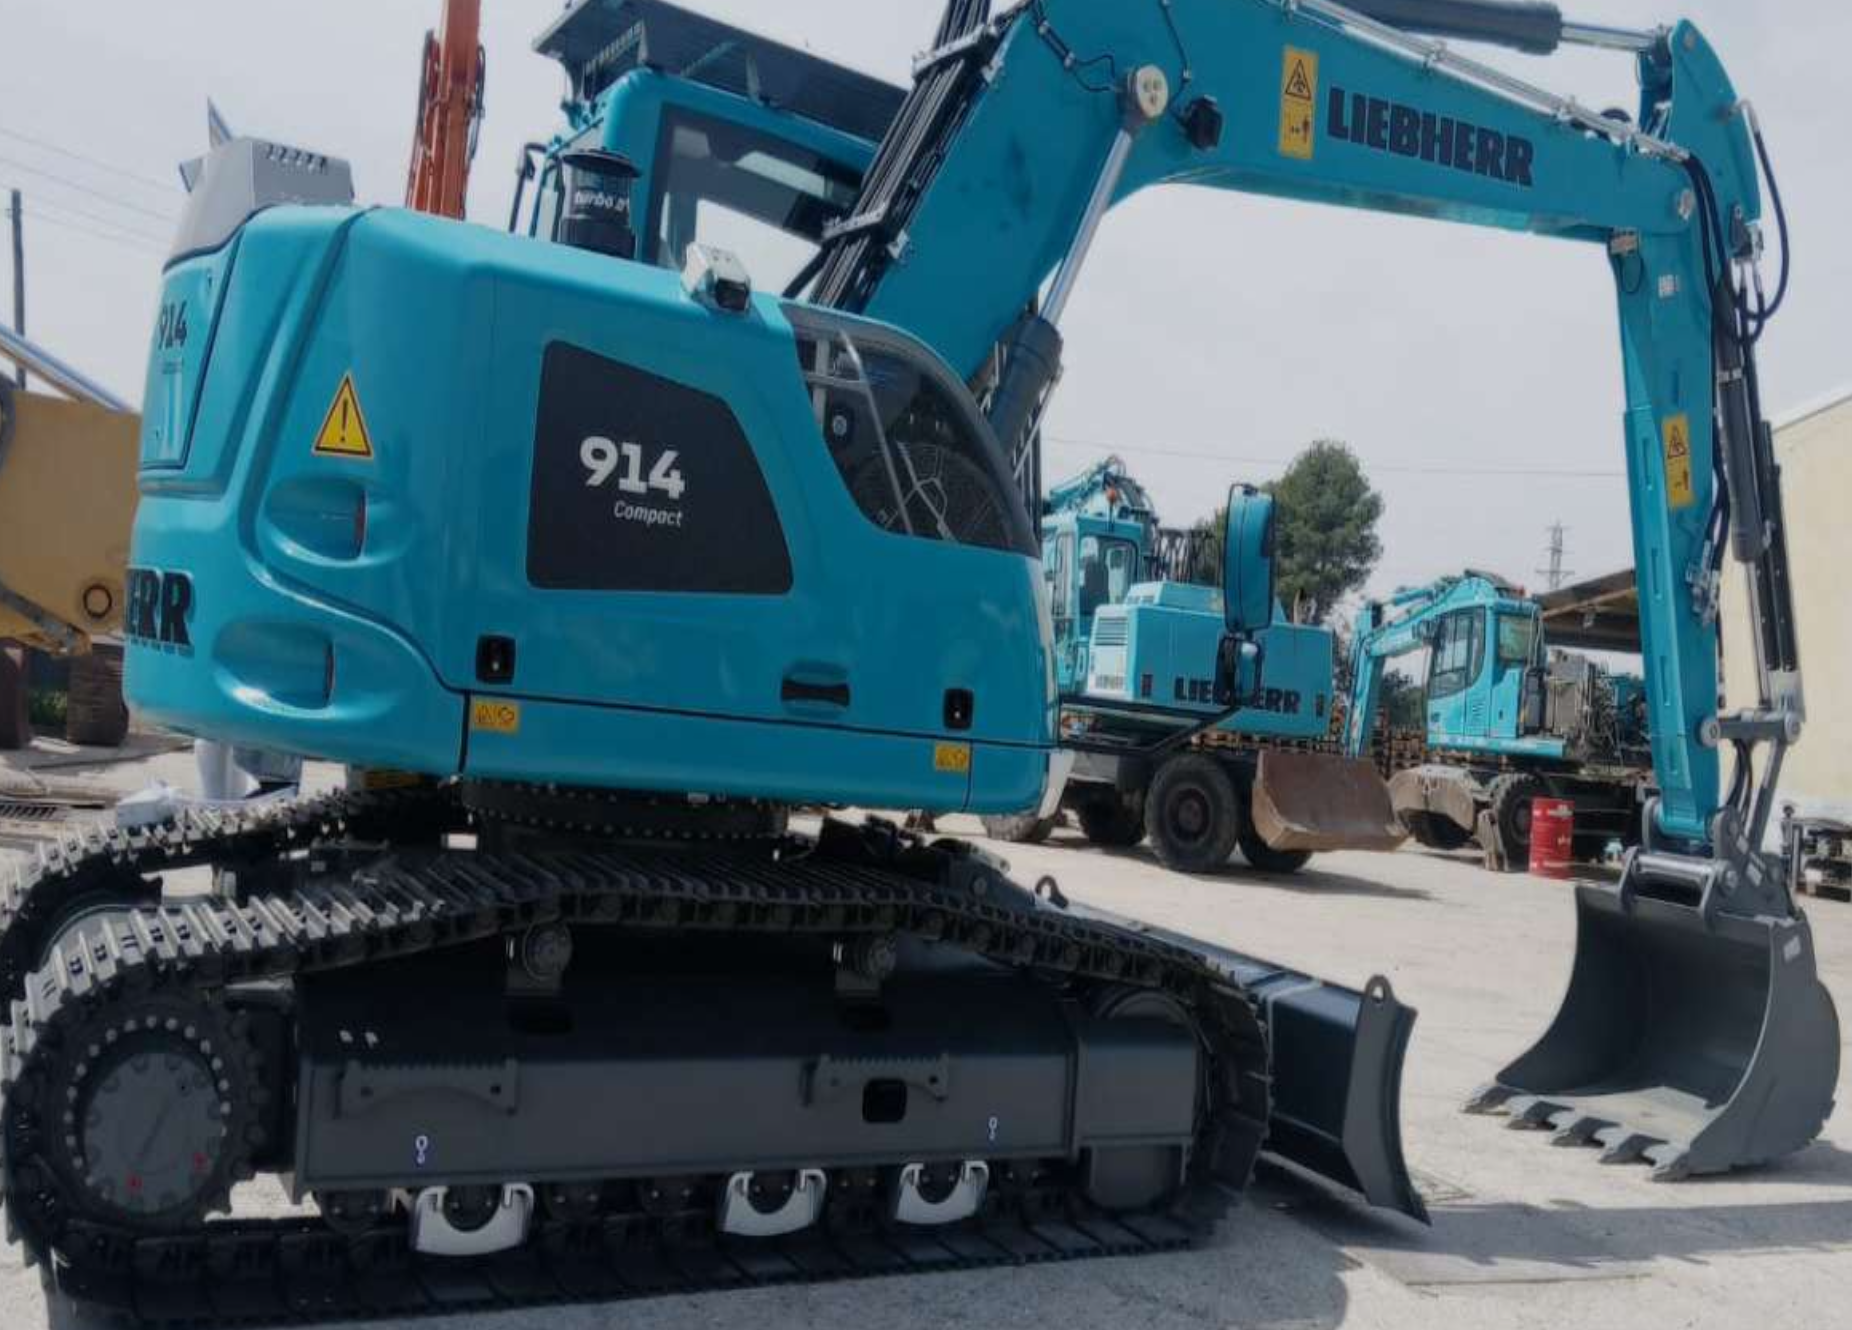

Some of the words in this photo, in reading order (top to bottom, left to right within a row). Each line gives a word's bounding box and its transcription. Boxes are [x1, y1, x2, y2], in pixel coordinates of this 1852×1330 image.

[1328, 86, 1533, 187] LIEBHERR
[158, 301, 187, 350] 914
[579, 435, 685, 500] 914
[614, 500, 683, 528] Compact
[1174, 677, 1301, 714] LIEERR
